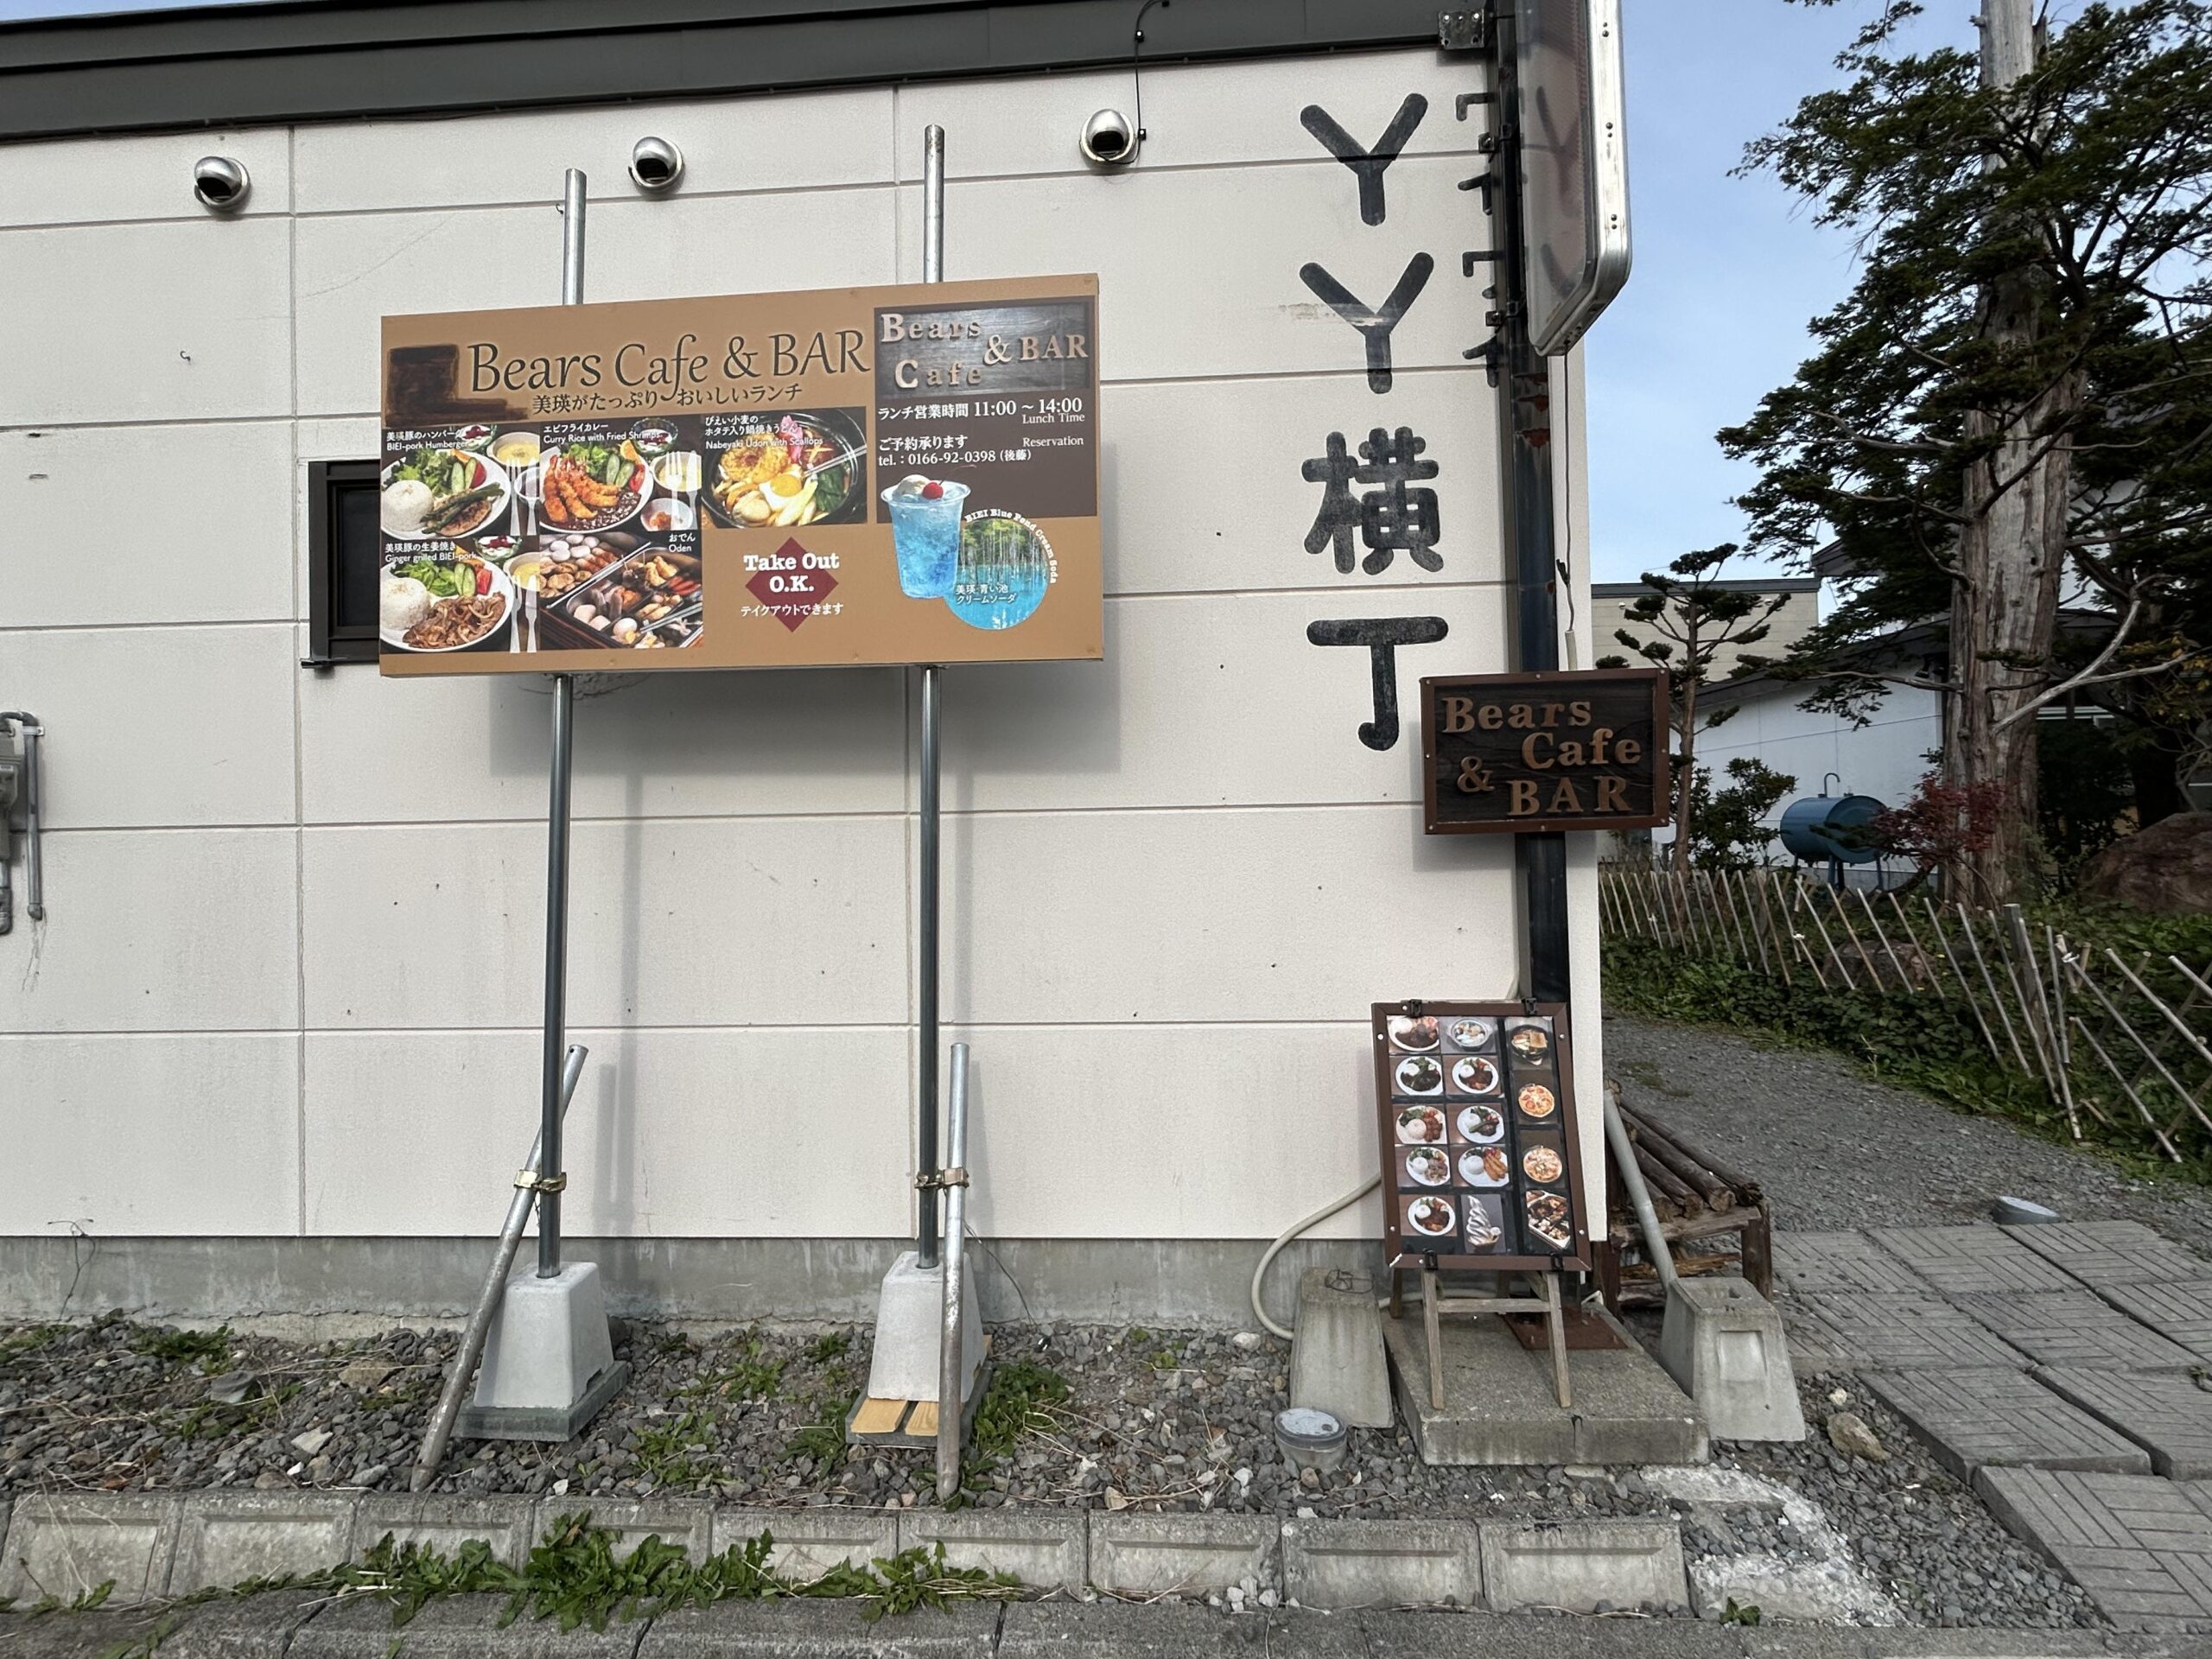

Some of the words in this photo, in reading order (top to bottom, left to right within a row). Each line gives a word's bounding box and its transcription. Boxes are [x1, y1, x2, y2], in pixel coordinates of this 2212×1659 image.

[881, 314, 982, 343] Bears
[983, 334, 1012, 365] &
[1020, 334, 1089, 361] BAR
[467, 342, 601, 392] Bears
[615, 334, 709, 401] Cafe
[722, 335, 760, 379] &
[768, 329, 872, 376] BAR
[894, 359, 982, 389] Cafe
[677, 383, 803, 406] おいしいランチ
[878, 403, 969, 421] ランチ営業時間
[974, 401, 1017, 416] 11:00
[1039, 397, 1083, 413] 14:00
[1022, 413, 1055, 424] Lunch
[1059, 412, 1085, 423] Time
[543, 423, 609, 434] エビフライカレー
[543, 435, 566, 445] Curry
[568, 433, 586, 442] Rice
[588, 431, 605, 442] with
[607, 430, 626, 441] Fried
[705, 439, 743, 451] Nabeyaki
[746, 438, 768, 448] Udon
[790, 436, 823, 447] Scallops
[879, 435, 968, 452] ご予約承ります
[1022, 435, 1084, 448] Reservation
[386, 442, 423, 453] BIEI-pork
[907, 450, 996, 465] 0166-92-0398
[669, 533, 696, 543] おでん
[964, 509, 988, 523] BIEI
[990, 508, 1013, 518] Blue
[1013, 512, 1037, 531] Pond
[1035, 529, 1054, 559] Cream
[1049, 560, 1058, 584] Soda
[669, 543, 691, 552] Oden
[385, 554, 411, 564] Ginger
[413, 553, 437, 563] grilled
[439, 551, 477, 562] BIEI-pork
[743, 554, 797, 571] Take
[802, 552, 840, 569] Out
[769, 575, 815, 593] O.K.
[957, 593, 1016, 604] クリームソーダ
[741, 603, 843, 617] テイクアウトできます
[1441, 696, 1592, 734] Bears
[1521, 728, 1642, 770] Cafe
[1457, 756, 1495, 793] &
[1508, 775, 1633, 816] BAR
